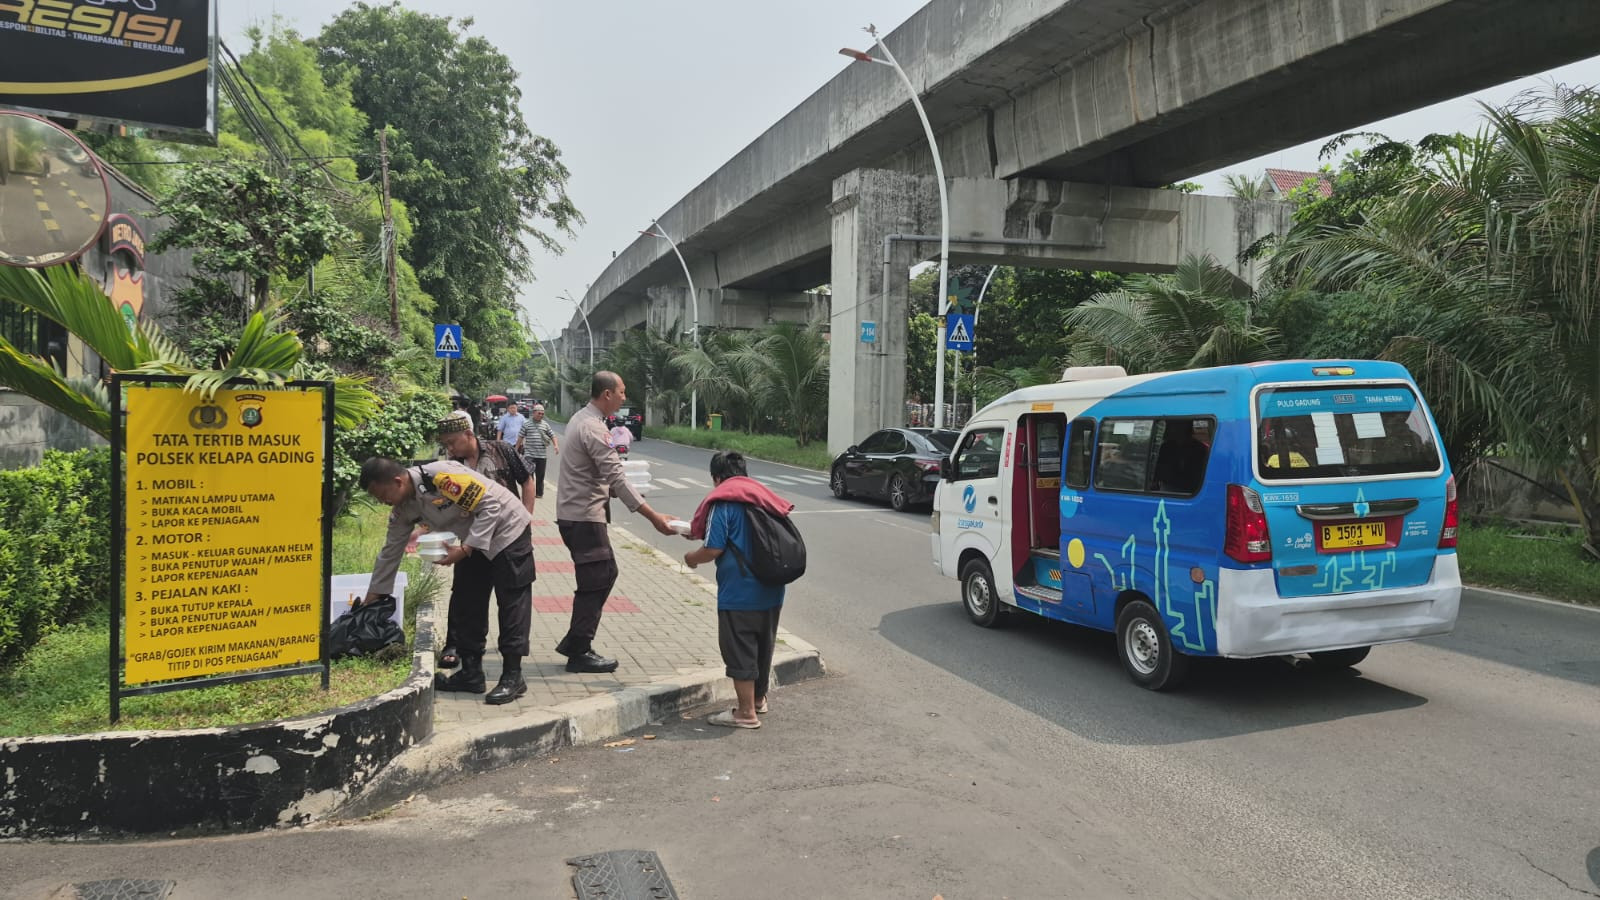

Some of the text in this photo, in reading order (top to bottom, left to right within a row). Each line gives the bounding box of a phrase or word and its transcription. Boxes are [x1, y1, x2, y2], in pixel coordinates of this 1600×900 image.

[153, 434, 300, 446] TATA TERTIB MASUK
[137, 451, 314, 465] POLSEK KELAPA GADING
[136, 480, 147, 490] 1.
[152, 479, 196, 490] MOBIL
[152, 496, 199, 505] MATIKAN
[202, 495, 238, 504] LAMPU
[240, 494, 275, 502] UTAMA
[152, 508, 180, 516] BUKA
[183, 507, 208, 516] KACA
[211, 506, 243, 514] MOBIL
[152, 519, 184, 528] LAPOR
[202, 516, 259, 526] PENJAGAAN
[136, 536, 148, 546] 2.
[152, 532, 202, 545] MOTOR
[1324, 527, 1331, 540] B
[1366, 523, 1383, 536] WV
[152, 551, 189, 561] MASUK
[198, 548, 235, 558] KELUAR
[238, 545, 285, 556] GUNAKAN
[288, 543, 313, 552] HELM
[152, 563, 179, 572] BUKA
[182, 560, 229, 570] PENUTUP
[232, 557, 265, 567] WAJAH
[274, 554, 312, 563] MASKER
[151, 574, 184, 583] LAPOR
[187, 568, 258, 580] KEPENJAGAAN
[136, 592, 147, 601] 3.
[151, 587, 208, 600] PEJALAN
[212, 584, 240, 595] KAKI
[151, 606, 179, 615] BUKA
[181, 603, 214, 613] TUTUP
[217, 598, 252, 609] KEPALA
[151, 616, 179, 627] BUKA
[182, 612, 228, 624] PENUTUP
[231, 607, 264, 618] WAJAH
[273, 604, 311, 614] MASKER
[151, 627, 184, 638] LAPOR
[186, 619, 257, 634] KEPENJAGAAN
[199, 644, 225, 656] KIRIM
[168, 661, 190, 672] TITIP
[193, 658, 202, 668] DI
[206, 656, 223, 667] POS
